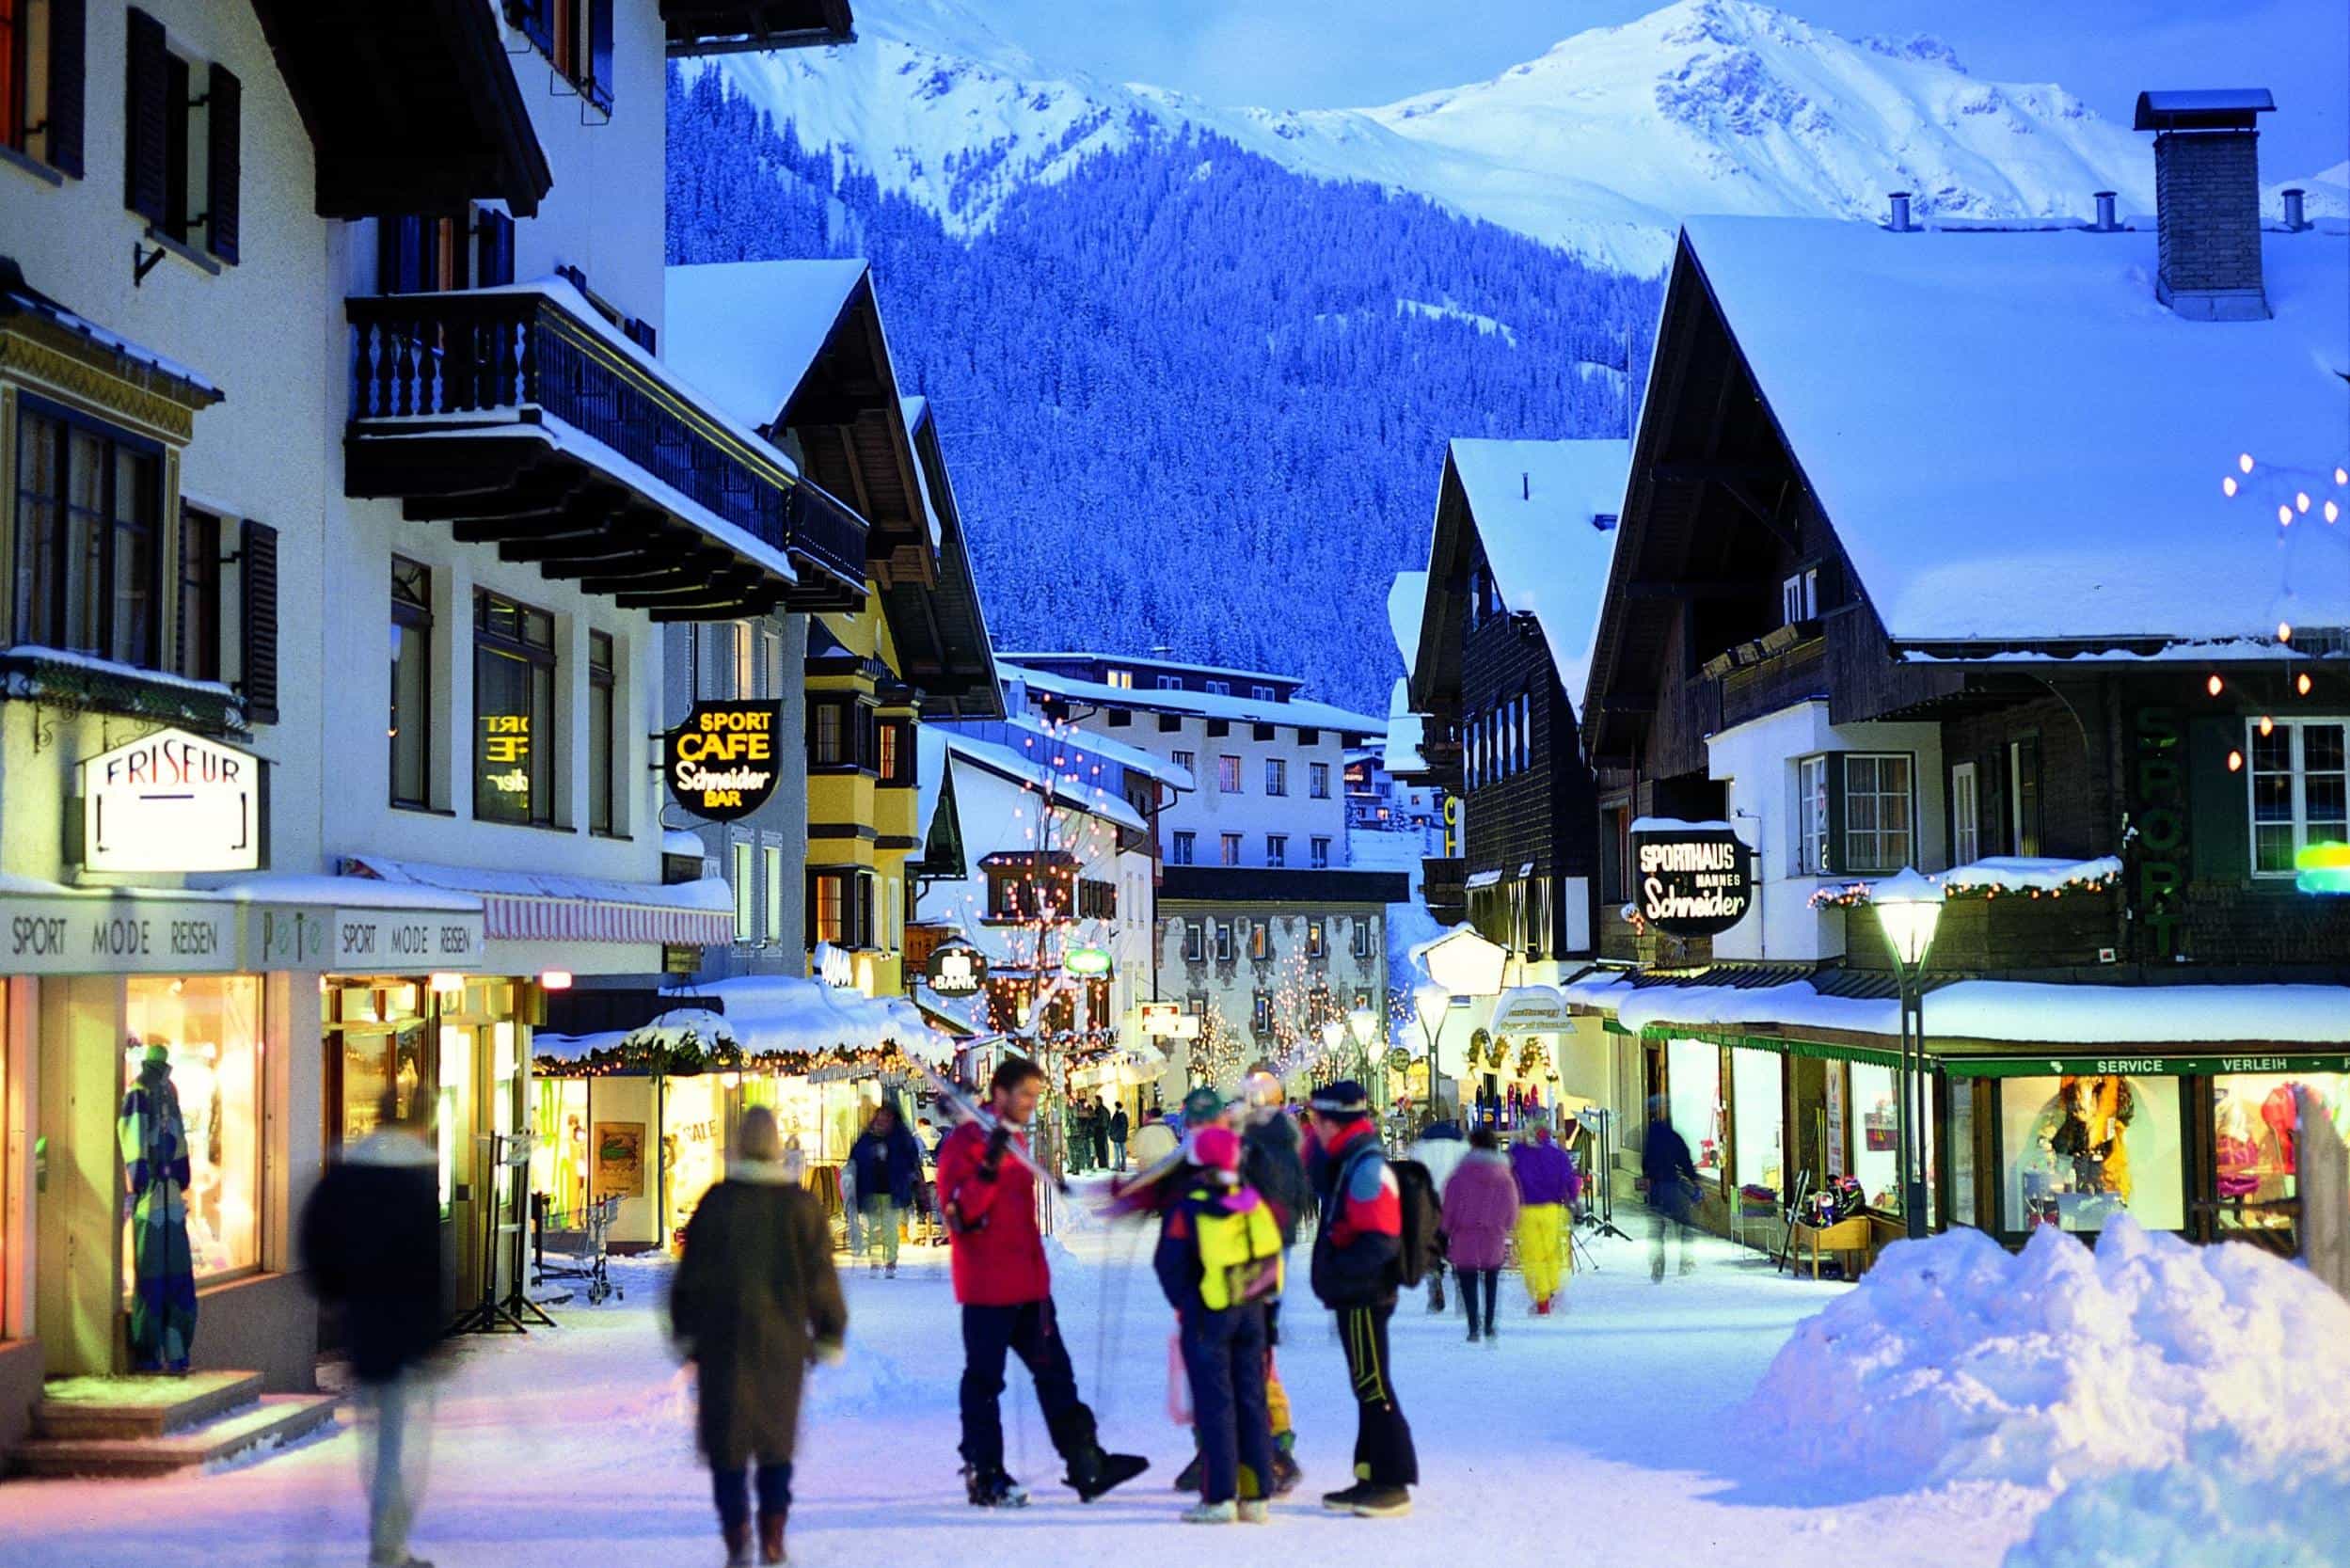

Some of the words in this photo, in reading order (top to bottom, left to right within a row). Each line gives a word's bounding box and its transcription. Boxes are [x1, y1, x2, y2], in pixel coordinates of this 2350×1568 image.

[700, 712, 772, 732] SPORT
[106, 738, 240, 785] FRISEUR
[677, 733, 770, 761] CAFE
[675, 760, 771, 791] Schneider
[704, 789, 742, 808] BAR
[2137, 706, 2182, 956] SPORT
[1640, 843, 1735, 873] SPORTHAUS
[1643, 877, 1745, 919] Schneider
[12, 916, 66, 955] SPORT
[93, 919, 150, 955] MODE
[171, 919, 218, 955] REISEN
[342, 923, 376, 954] SPORT
[391, 926, 428, 955] MODE
[440, 927, 469, 954] REISEN
[934, 974, 978, 990] BANK
[2097, 1060, 2164, 1073] SERVICE
[2222, 1057, 2288, 1071] VERLEIH
